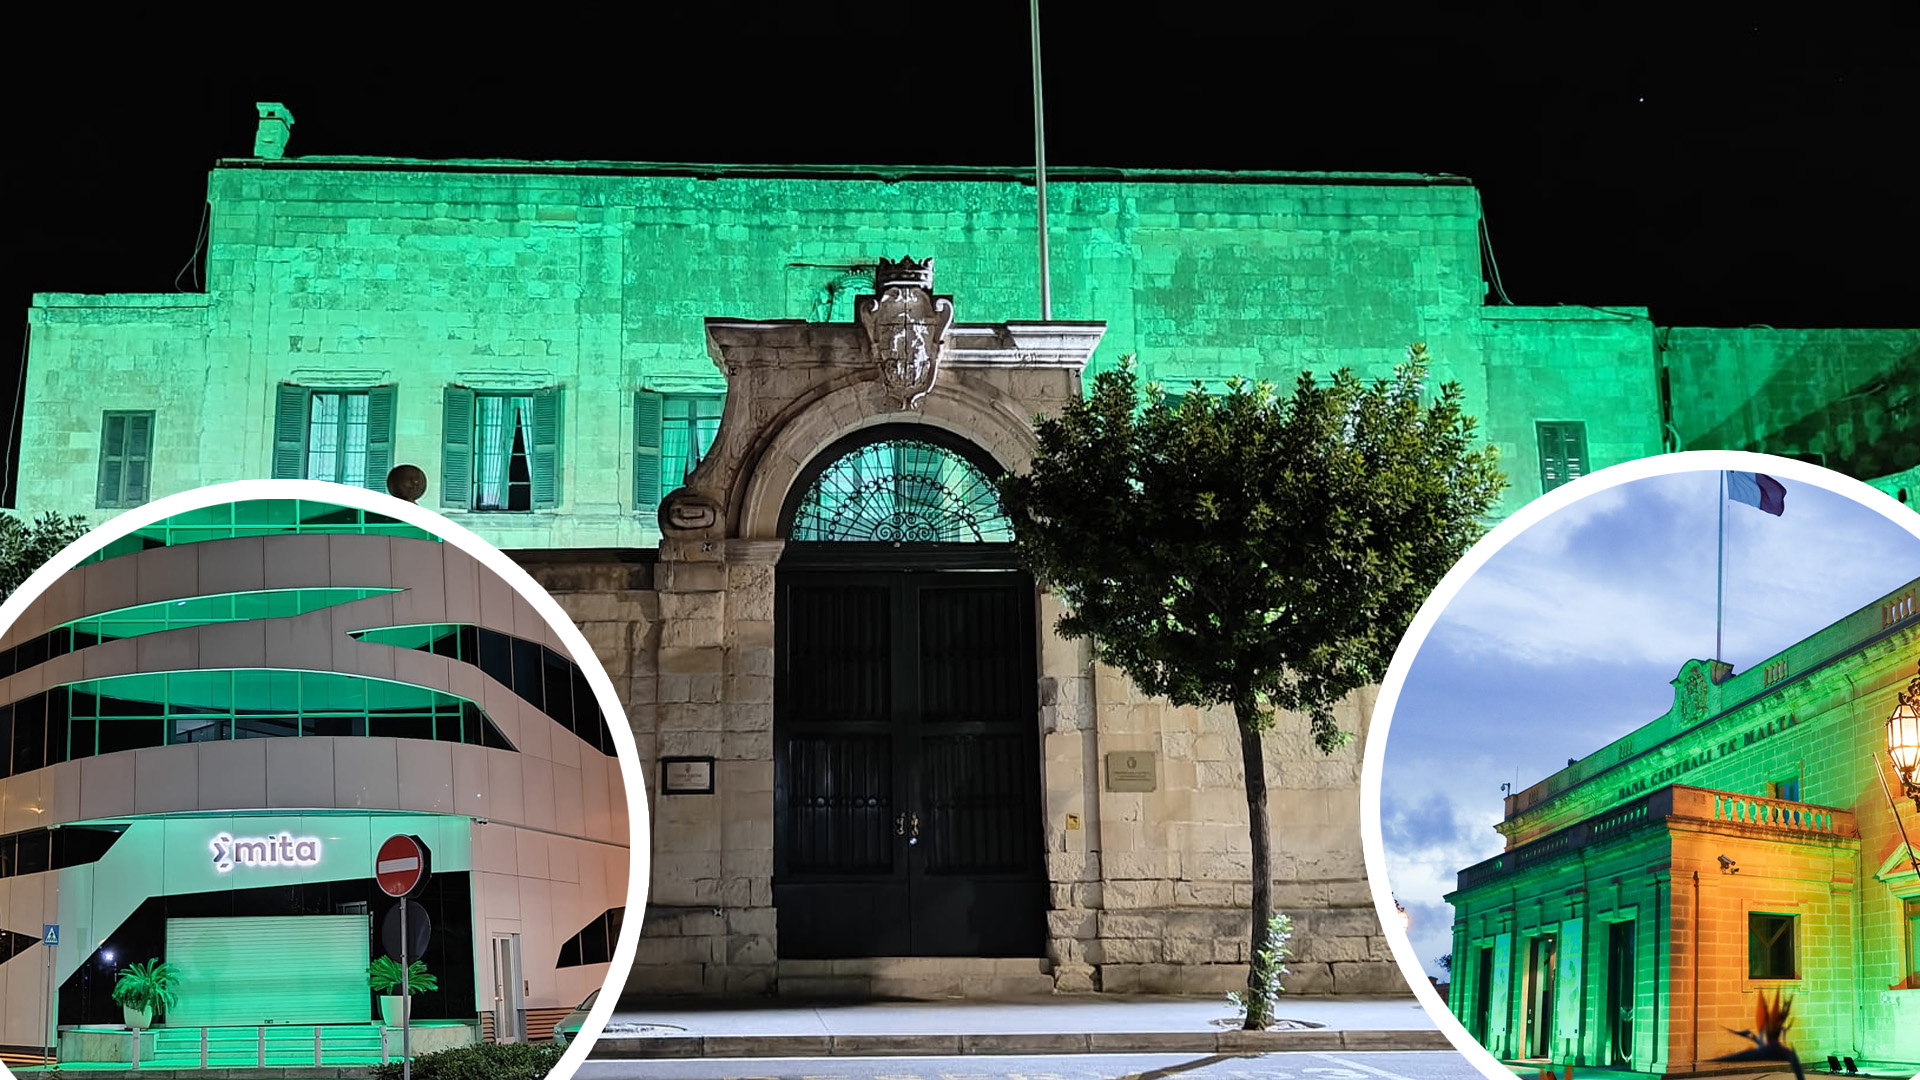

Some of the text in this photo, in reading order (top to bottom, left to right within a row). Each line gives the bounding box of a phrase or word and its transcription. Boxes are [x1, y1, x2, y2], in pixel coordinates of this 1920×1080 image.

[1618, 778, 1647, 800] BANK
[1650, 748, 1713, 786] CENTRALI
[1743, 712, 1799, 747] MALTA
[235, 835, 317, 862] mita
